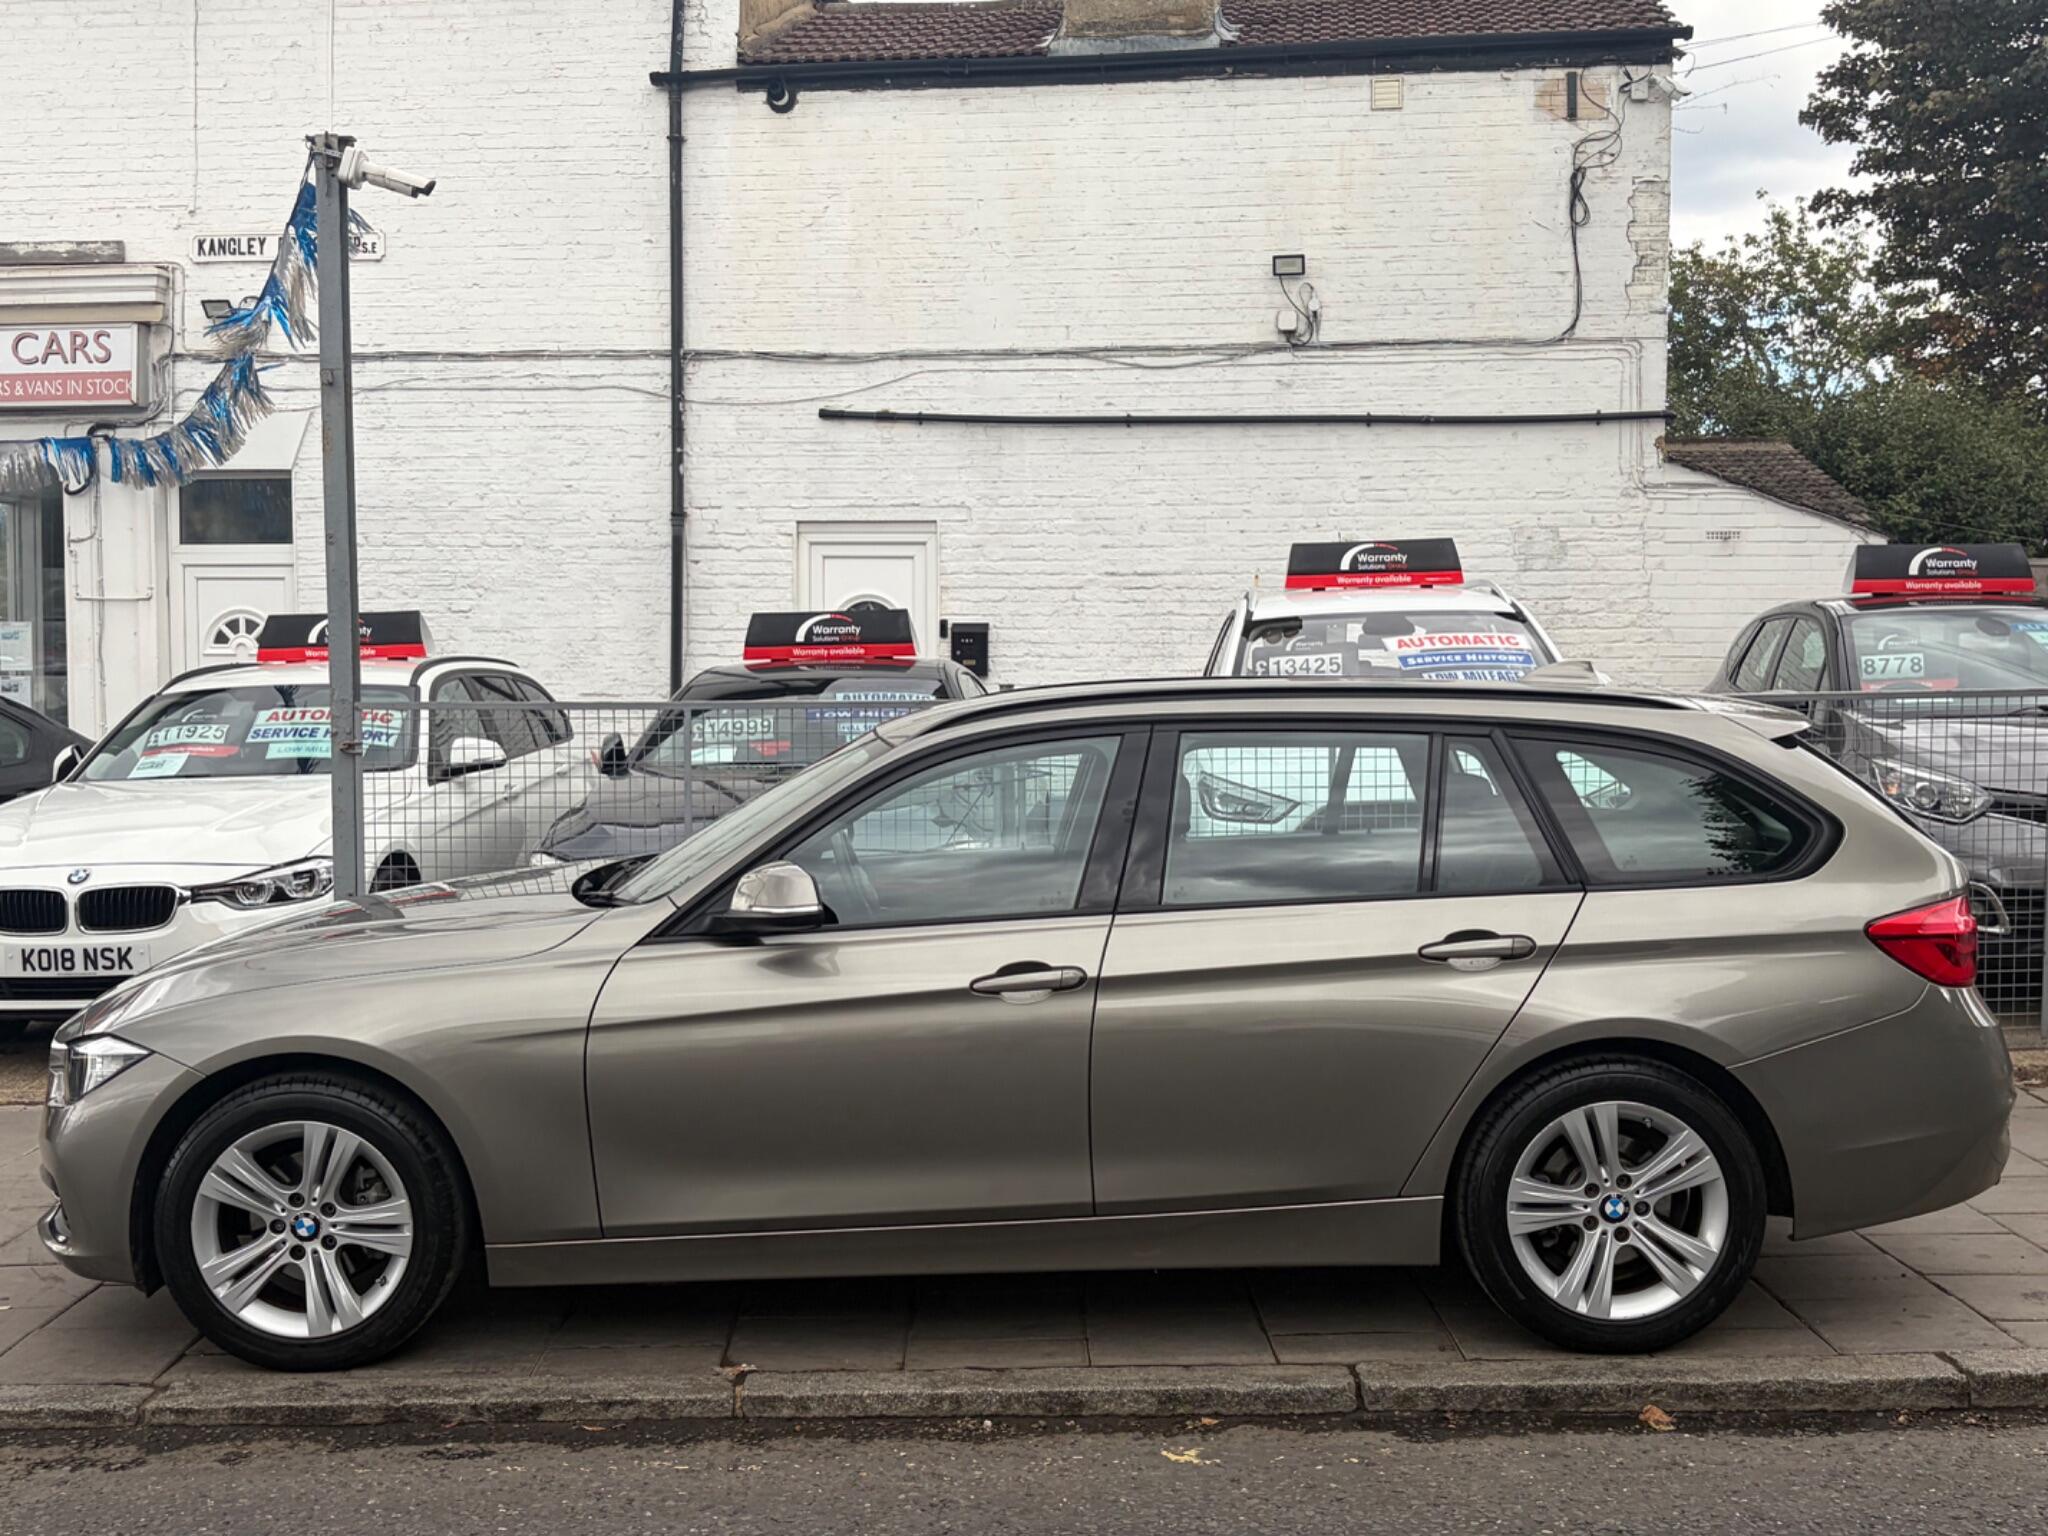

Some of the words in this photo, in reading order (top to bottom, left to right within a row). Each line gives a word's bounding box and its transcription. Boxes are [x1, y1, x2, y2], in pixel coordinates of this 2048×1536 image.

[197, 237, 266, 256] KANGLEY
[11, 330, 112, 365] CARS
[14, 380, 24, 395] &
[25, 380, 63, 395] VANS
[67, 379, 83, 394] IN
[1357, 553, 1407, 563] Warranty
[1925, 558, 1978, 570] Warranty
[1337, 575, 1373, 585] Warranty
[1374, 574, 1412, 584] available
[1905, 580, 1943, 591] Warranty
[1944, 580, 1983, 590] available
[812, 625, 861, 635] Warranty
[1397, 635, 1520, 649] AUTOMATIC
[793, 648, 828, 657] Warranty
[829, 646, 866, 656] available
[1863, 656, 1923, 676] 8778
[251, 727, 320, 740] SERVICE
[83, 946, 134, 971] NSK
